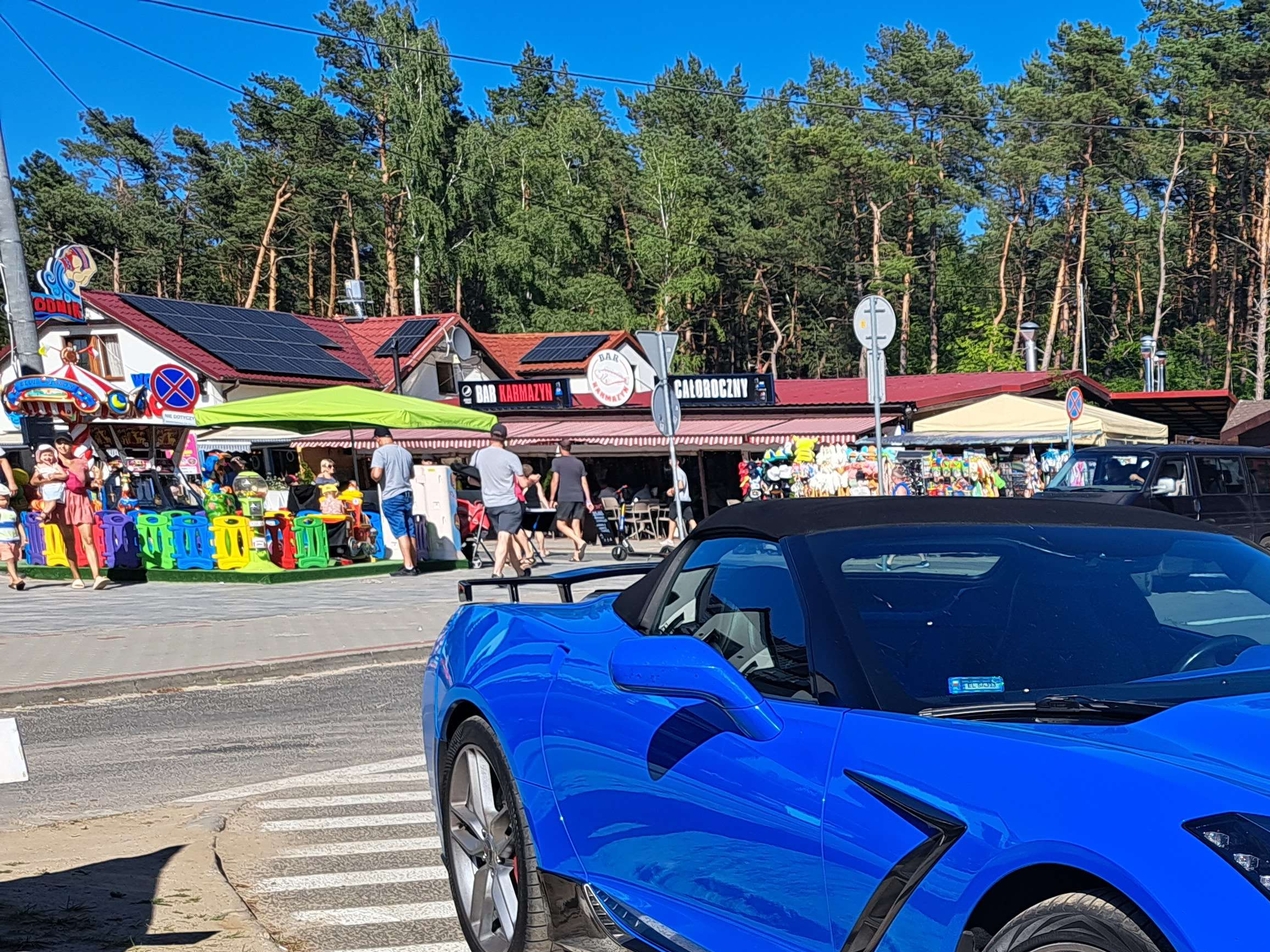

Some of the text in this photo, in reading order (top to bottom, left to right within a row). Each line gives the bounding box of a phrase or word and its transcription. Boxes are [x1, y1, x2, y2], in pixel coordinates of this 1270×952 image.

[34, 297, 83, 319] ODNIK
[598, 352, 619, 362] BAR
[475, 382, 553, 404] BAR KARMAZYN
[592, 382, 629, 402] KARMAZYN
[674, 378, 748, 399] CAŁOROCZNY
